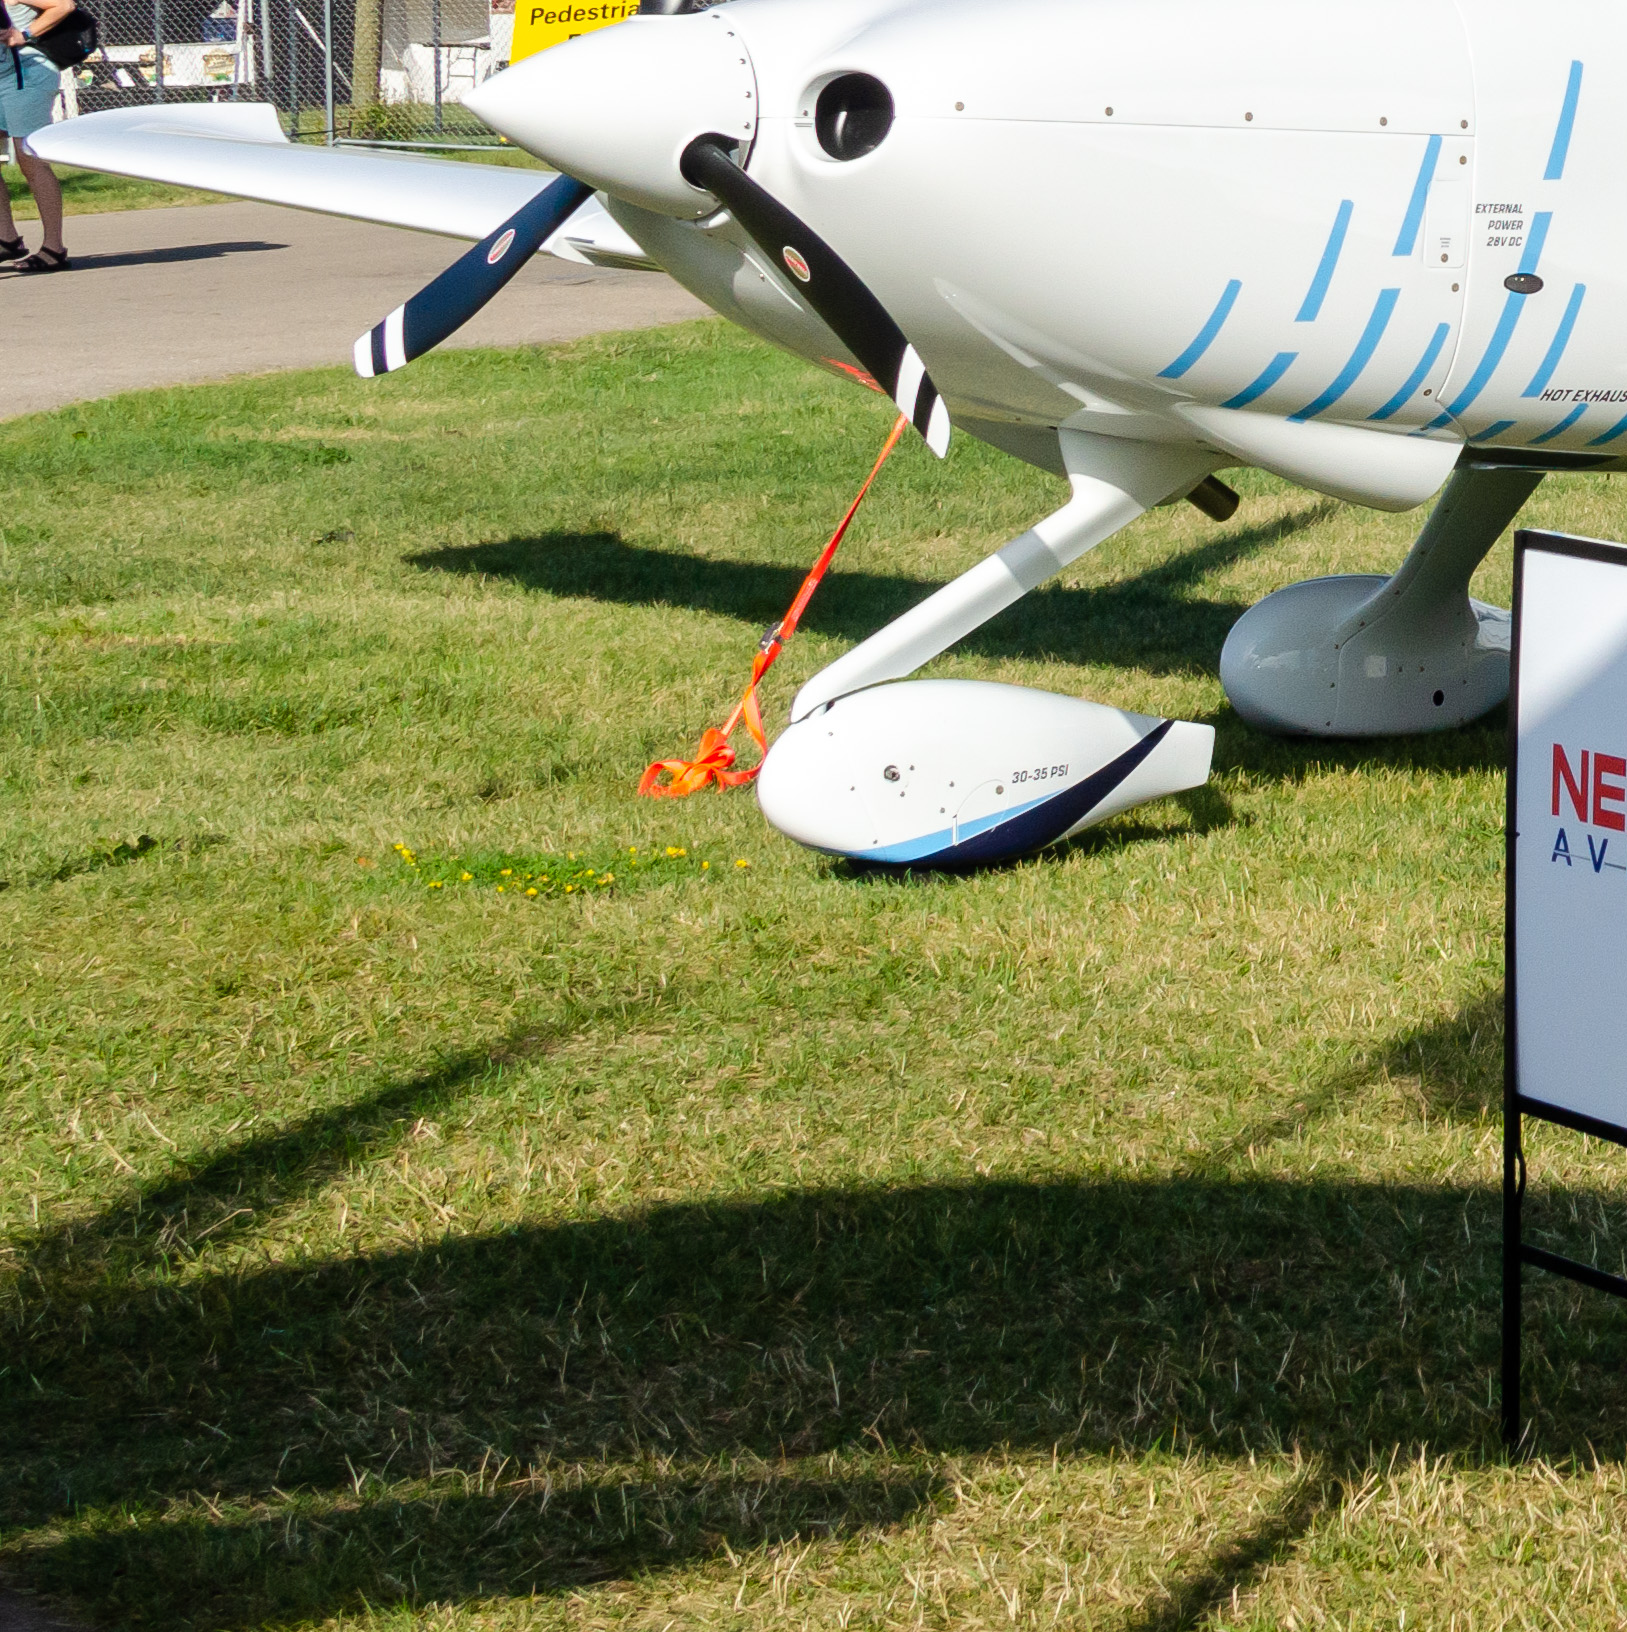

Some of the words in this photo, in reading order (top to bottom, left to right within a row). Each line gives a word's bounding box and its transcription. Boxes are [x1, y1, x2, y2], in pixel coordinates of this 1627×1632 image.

[530, 0, 640, 26] Pedestria
[1475, 203, 1524, 214] EXTERNAL
[1488, 220, 1524, 230] POWER
[1486, 236, 1508, 247] 28V
[1508, 236, 1523, 247] DC
[1540, 389, 1573, 402] HOT
[1011, 766, 1049, 785] 30-35
[1051, 764, 1069, 779] PSI
